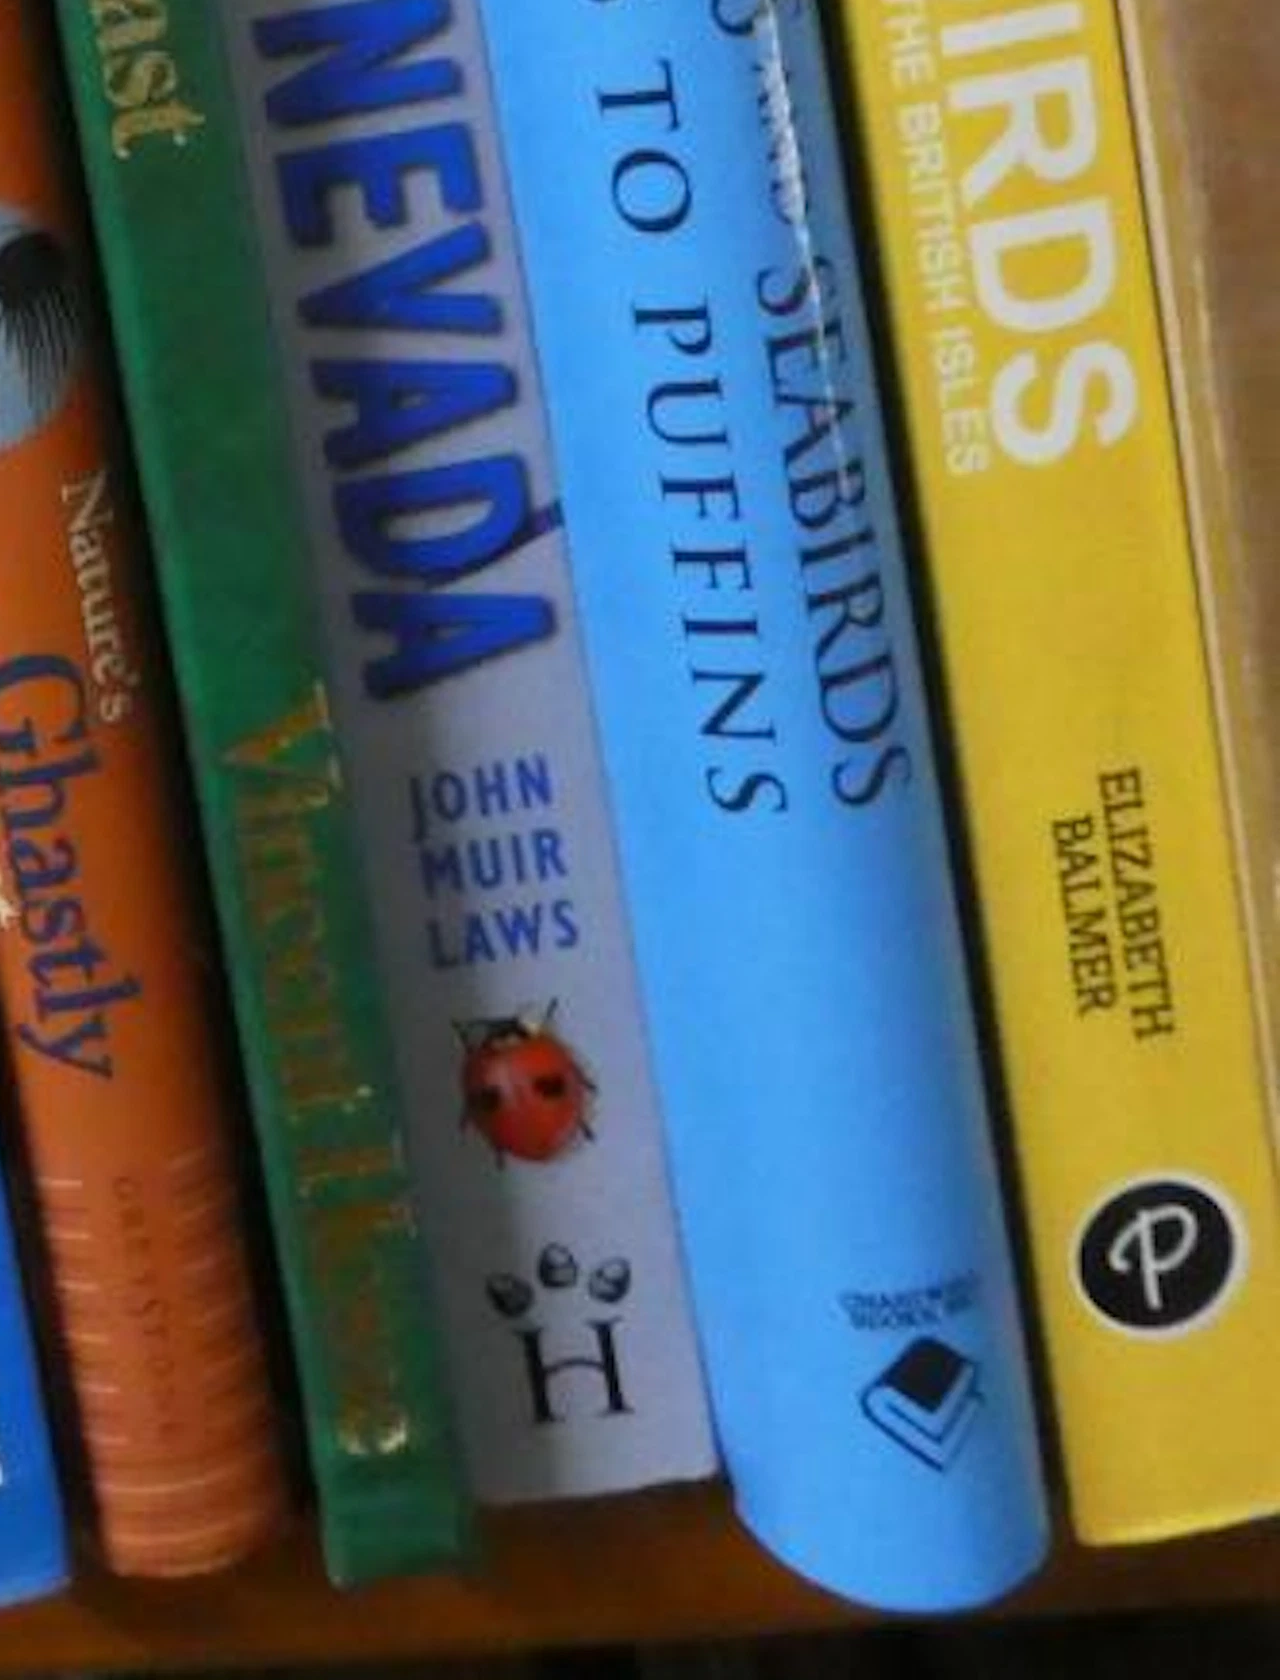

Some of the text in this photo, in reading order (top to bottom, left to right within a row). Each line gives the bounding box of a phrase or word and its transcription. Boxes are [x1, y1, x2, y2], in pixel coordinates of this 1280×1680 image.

[596, 56, 693, 235] TO
[892, 100, 975, 320] BRITISH
[933, 324, 991, 476] ISLES
[60, 468, 138, 724] Nature's
[632, 296, 789, 816] PUFFINS
[755, 254, 912, 807] SEABIRDS
[408, 752, 555, 843] JOHN
[416, 826, 569, 900] MUIR
[428, 897, 582, 971] LAWS
[1052, 815, 1116, 1017] BALMER
[1098, 765, 1175, 1041] ELIZABETH
